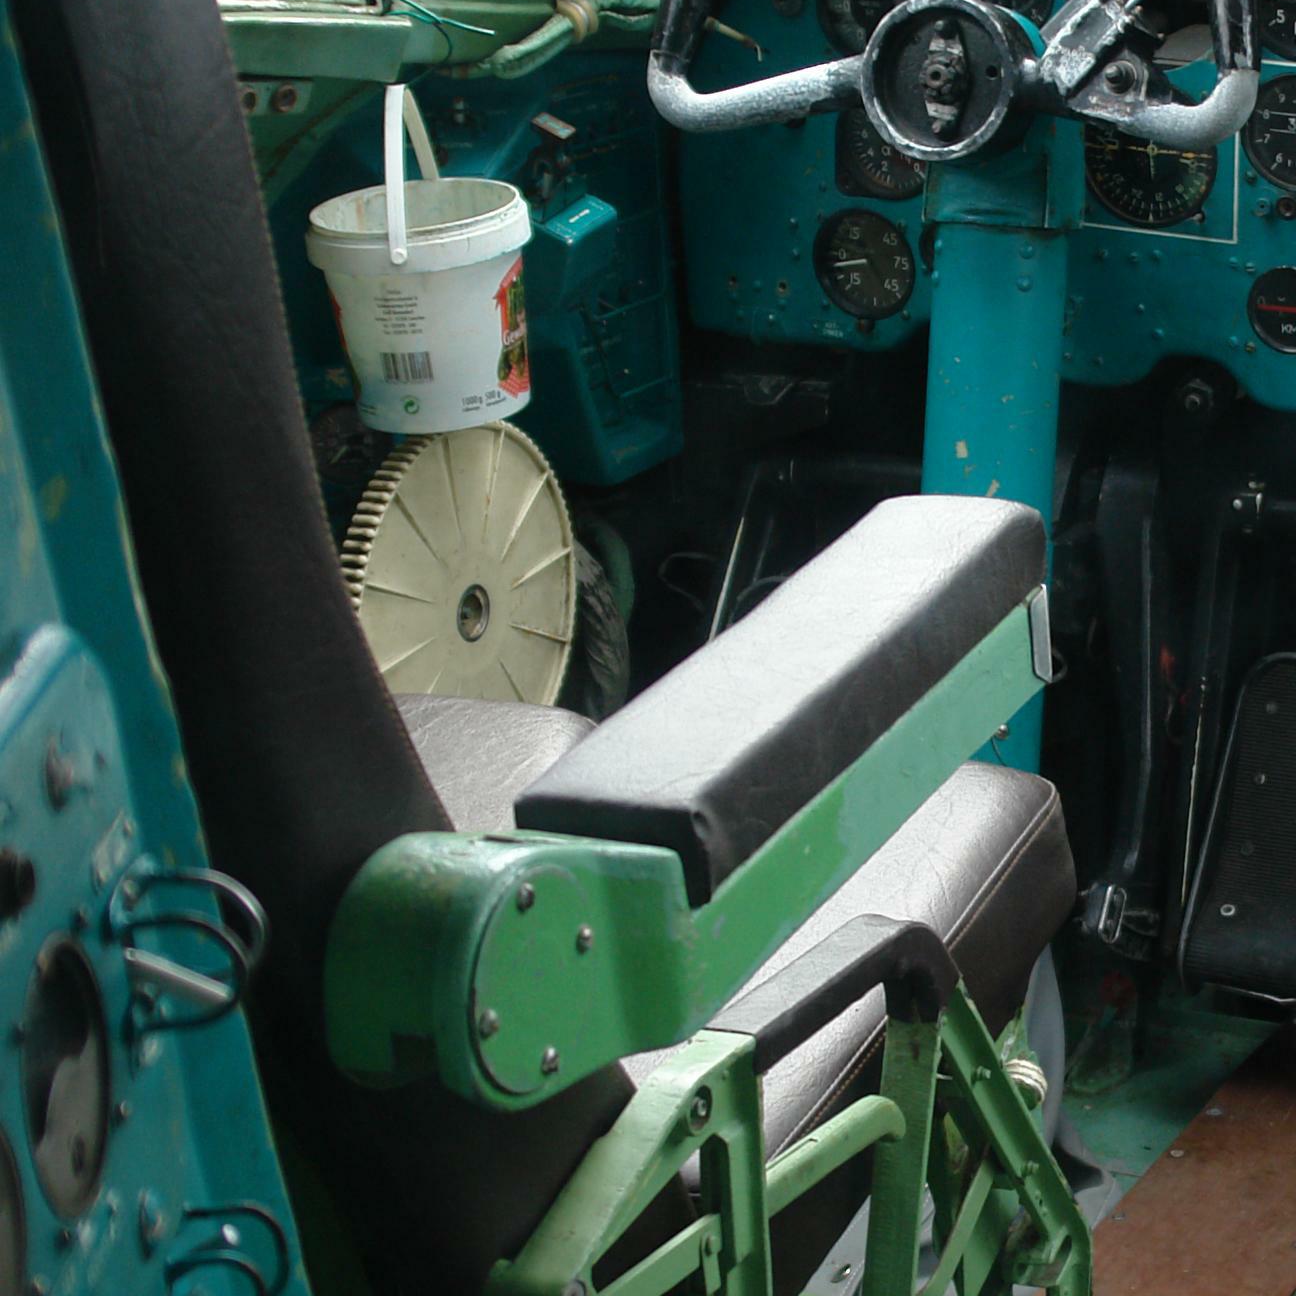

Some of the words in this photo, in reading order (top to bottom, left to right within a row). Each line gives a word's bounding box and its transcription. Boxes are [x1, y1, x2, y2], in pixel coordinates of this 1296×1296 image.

[1276, 9, 1285, 23] 5
[1279, 93, 1286, 104] 9
[1263, 109, 1270, 120] 8
[1263, 133, 1271, 143] 7
[867, 148, 874, 156] 4
[1275, 152, 1283, 163] 6
[881, 161, 889, 172] 2
[913, 162, 920, 173] 0
[882, 231, 898, 246] 45
[838, 249, 846, 259] 0
[893, 256, 909, 270] 75
[849, 272, 861, 285] 15
[883, 278, 899, 292] 45
